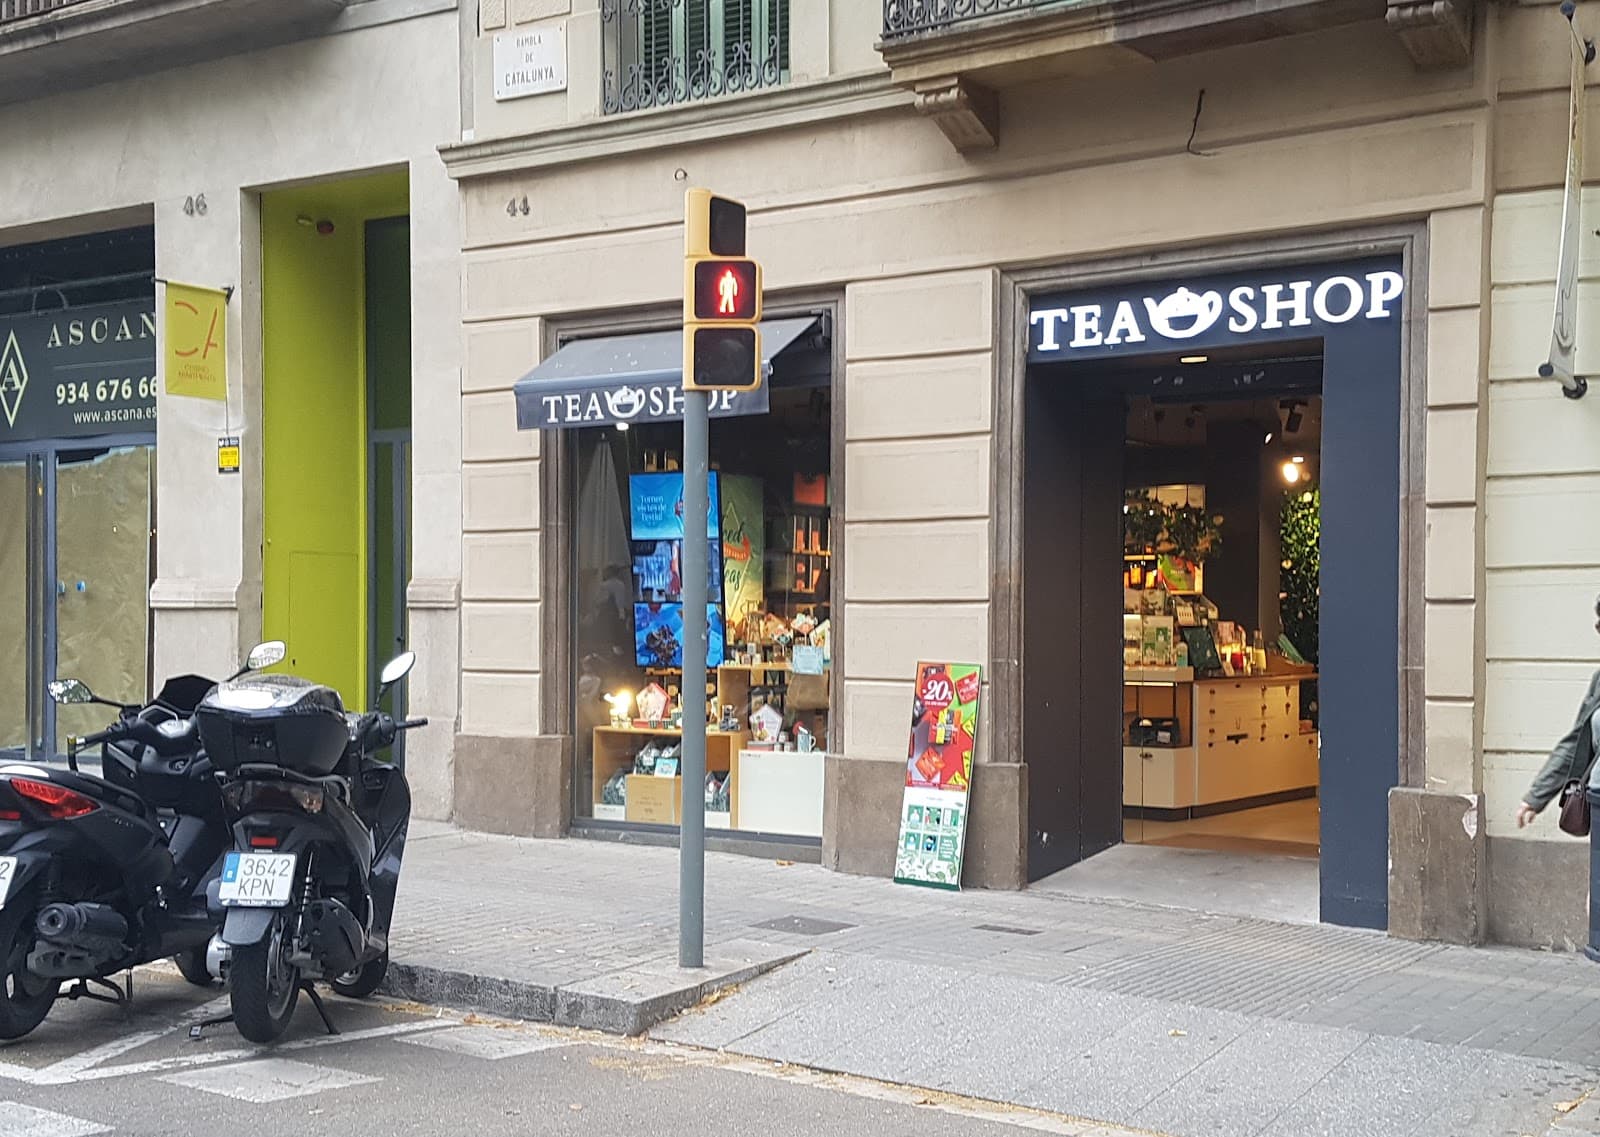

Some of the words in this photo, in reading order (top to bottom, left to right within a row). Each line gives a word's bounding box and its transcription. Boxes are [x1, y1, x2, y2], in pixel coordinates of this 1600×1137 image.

[516, 34, 542, 48] RAMBLA
[525, 52, 534, 63] DE
[505, 65, 554, 87] CATALUNYA
[183, 192, 208, 216] 46
[506, 195, 531, 217] 44
[1029, 299, 1146, 352] TEA
[1228, 270, 1404, 334] SHOP
[56, 380, 90, 405] 934
[96, 377, 132, 401] 676
[73, 405, 157, 424] www.ascana.es
[542, 393, 604, 424] TEA
[649, 385, 738, 416] SHP
[242, 858, 291, 877] 3642
[238, 878, 275, 897] KPN
